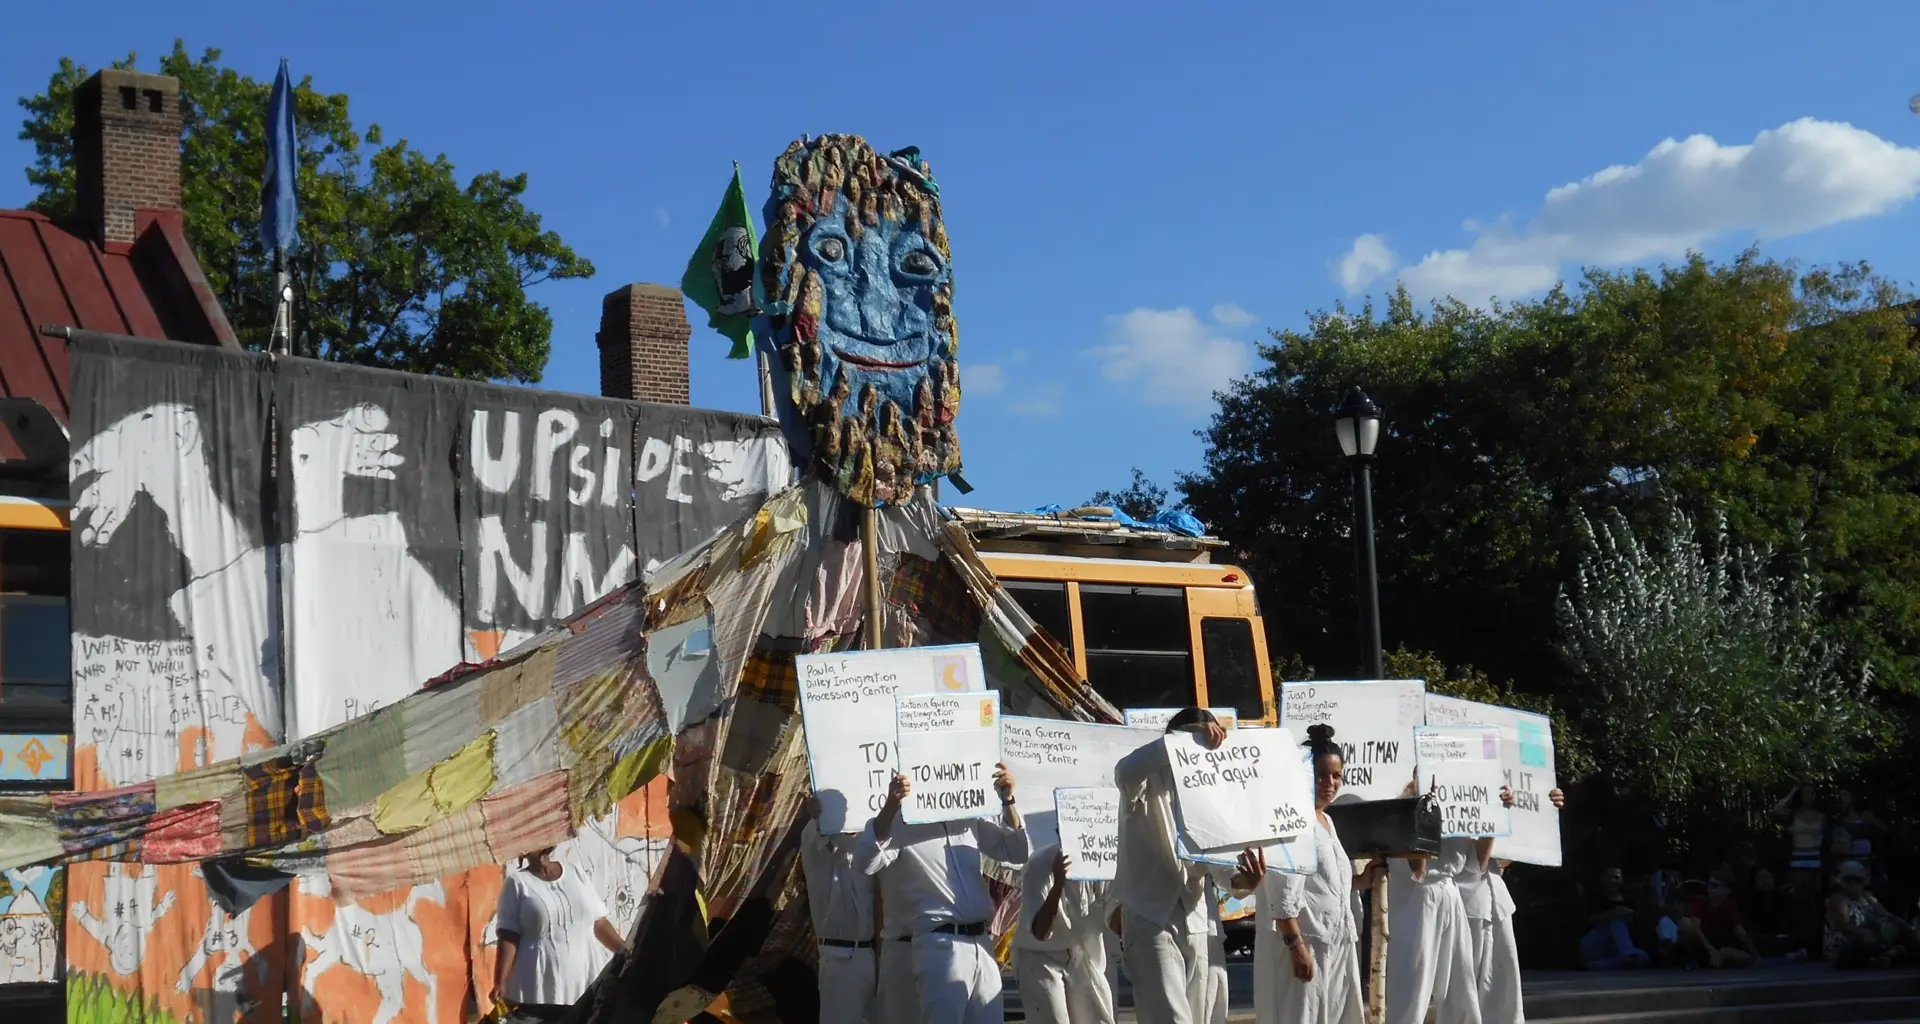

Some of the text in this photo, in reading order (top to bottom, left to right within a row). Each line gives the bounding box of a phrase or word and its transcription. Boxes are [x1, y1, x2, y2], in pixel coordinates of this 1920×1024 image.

[82, 638, 192, 660] WHAT WHY WHO
[116, 659, 140, 673] NOT
[806, 660, 848, 678] Paula F
[806, 678, 831, 689] Dilley
[806, 685, 899, 704] Processing Center
[930, 698, 960, 709] Guerra
[1287, 688, 1316, 701] Juan D
[931, 719, 954, 727] Center
[1004, 724, 1071, 740] Maria Guerra
[859, 741, 887, 764] TO
[1004, 748, 1079, 766] Processing Center
[1175, 745, 1261, 774] No quiero
[1363, 741, 1375, 764] IT
[1376, 741, 1399, 764] MAY
[869, 769, 884, 788] IT
[912, 764, 931, 782] TO
[933, 763, 965, 781] WHOM
[970, 762, 981, 781] IT
[1183, 759, 1260, 790] estar aquí
[1341, 767, 1372, 786] NCERN
[1520, 771, 1532, 791] IT
[917, 788, 985, 810] MAY CONCERN
[1438, 785, 1488, 805] O WHOM
[1445, 805, 1481, 820] IT MAY
[1269, 817, 1307, 835] 7 AÑOS
[1099, 834, 1119, 849] WHO
[351, 924, 380, 948] #2
